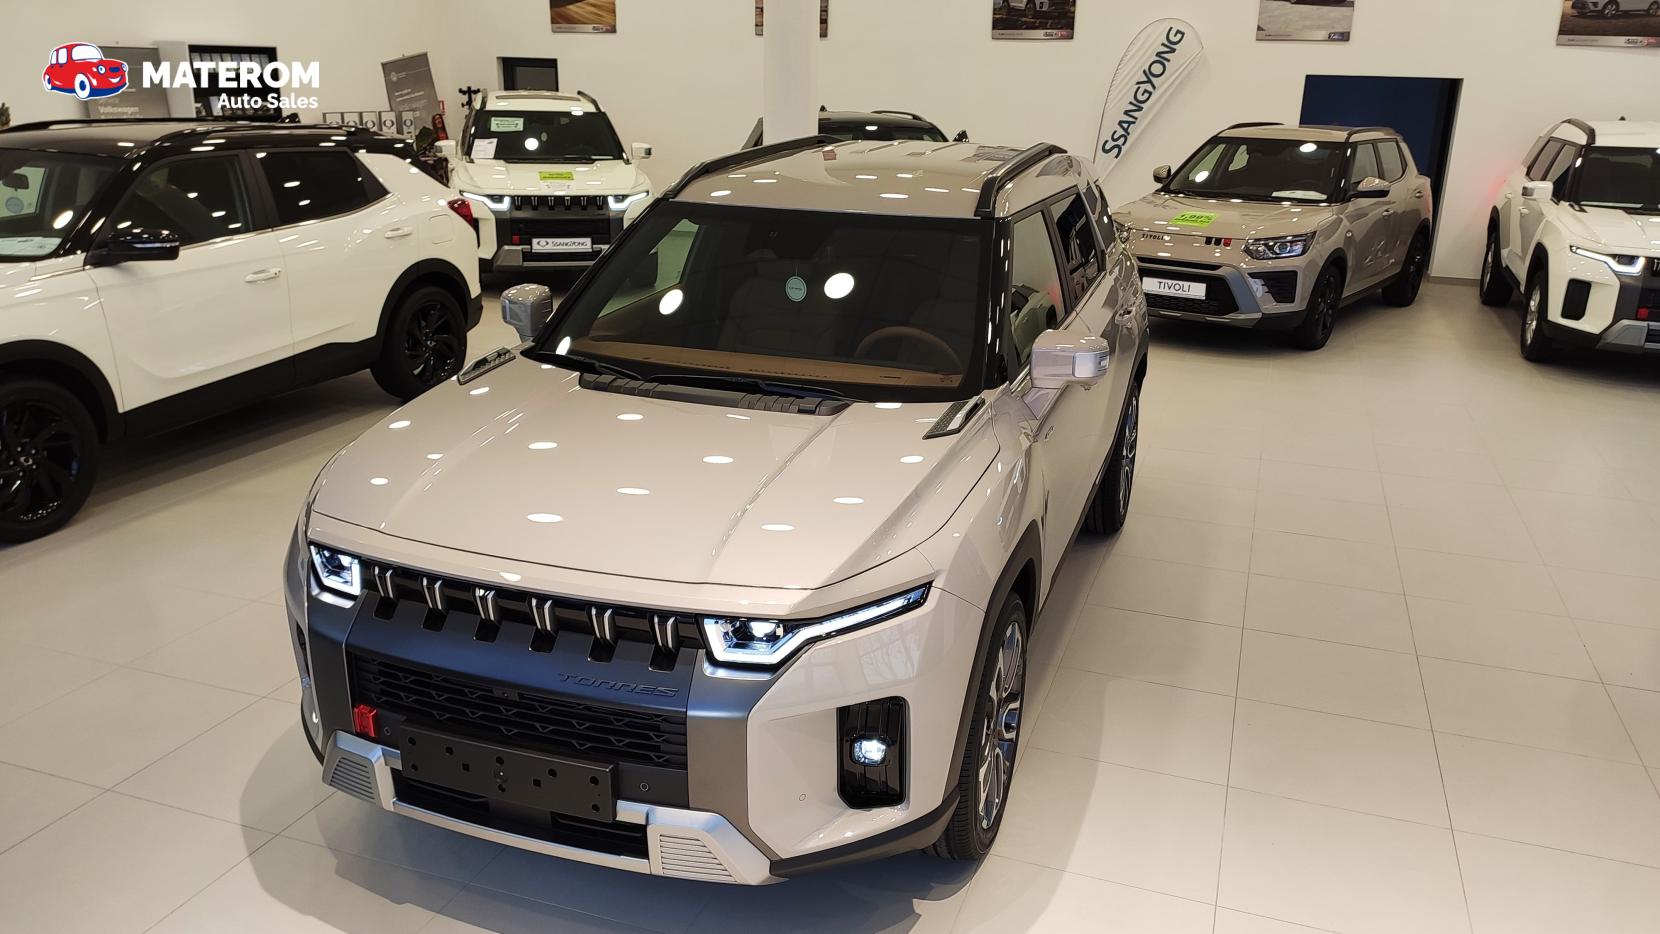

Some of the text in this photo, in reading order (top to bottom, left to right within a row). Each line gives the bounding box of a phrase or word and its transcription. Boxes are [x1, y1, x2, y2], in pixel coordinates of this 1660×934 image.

[1102, 26, 1185, 159] SSANGYONG
[1141, 232, 1164, 240] TIVOLI
[1157, 280, 1191, 293] TIVOLI
[558, 673, 679, 698] TORRES
